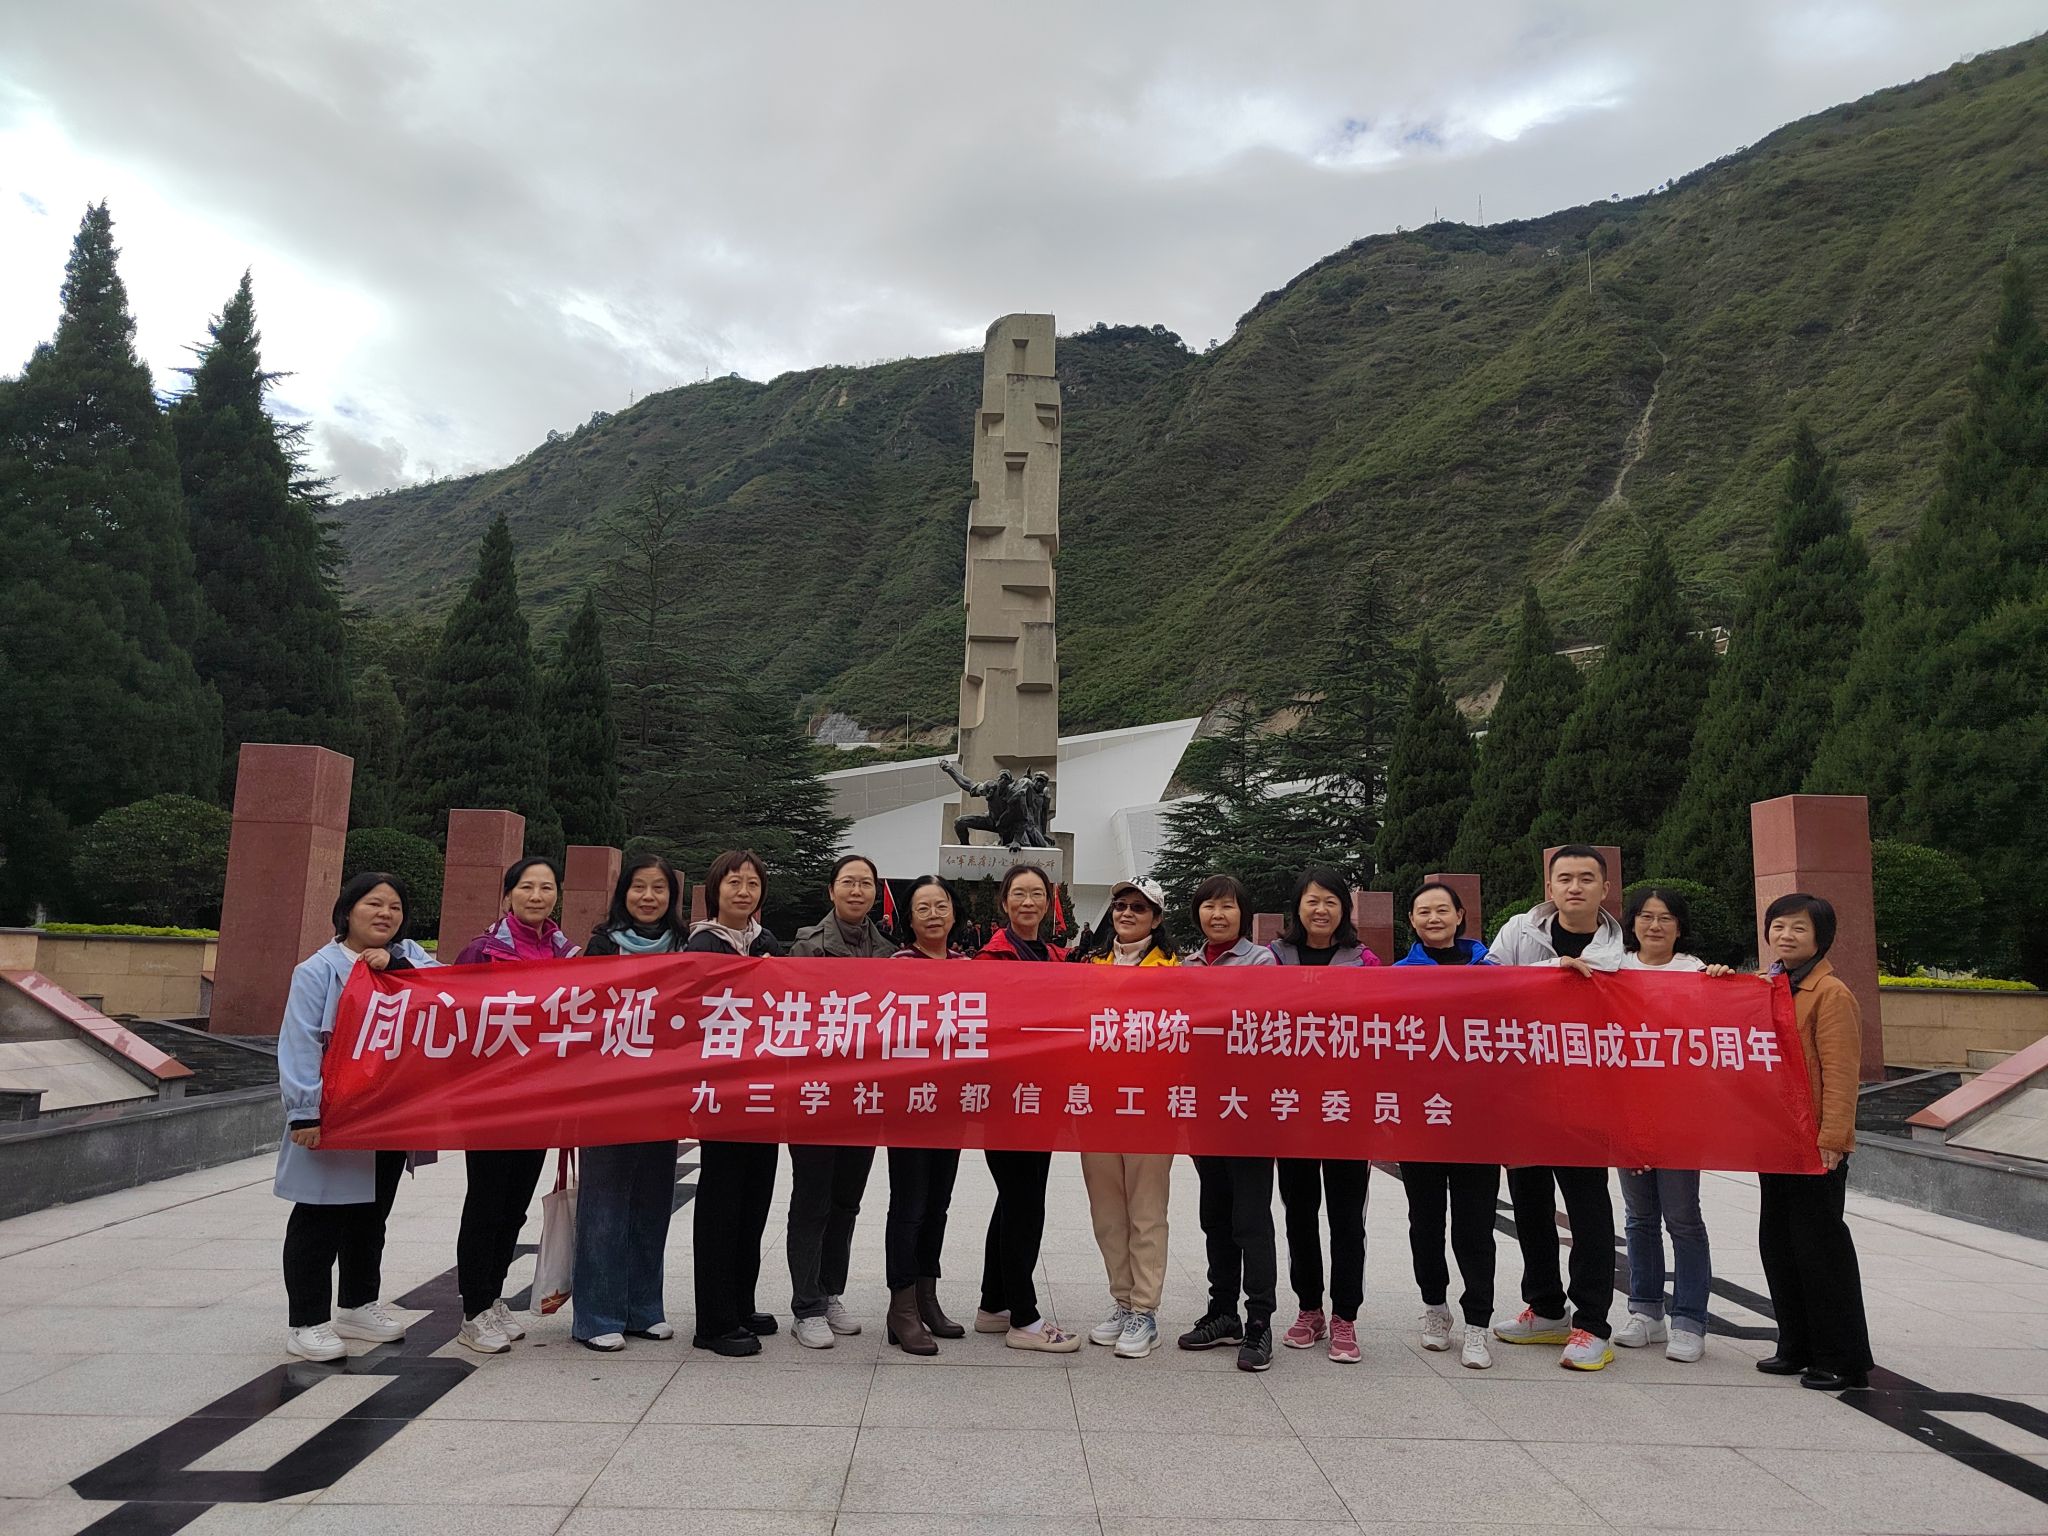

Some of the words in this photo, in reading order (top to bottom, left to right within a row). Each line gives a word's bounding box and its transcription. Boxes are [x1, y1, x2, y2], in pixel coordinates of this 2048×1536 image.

[352, 986, 989, 1061] 同心庆华诞·奋进新征程
[690, 1080, 1453, 1126] 九三学社成都信息工程大学委员会
